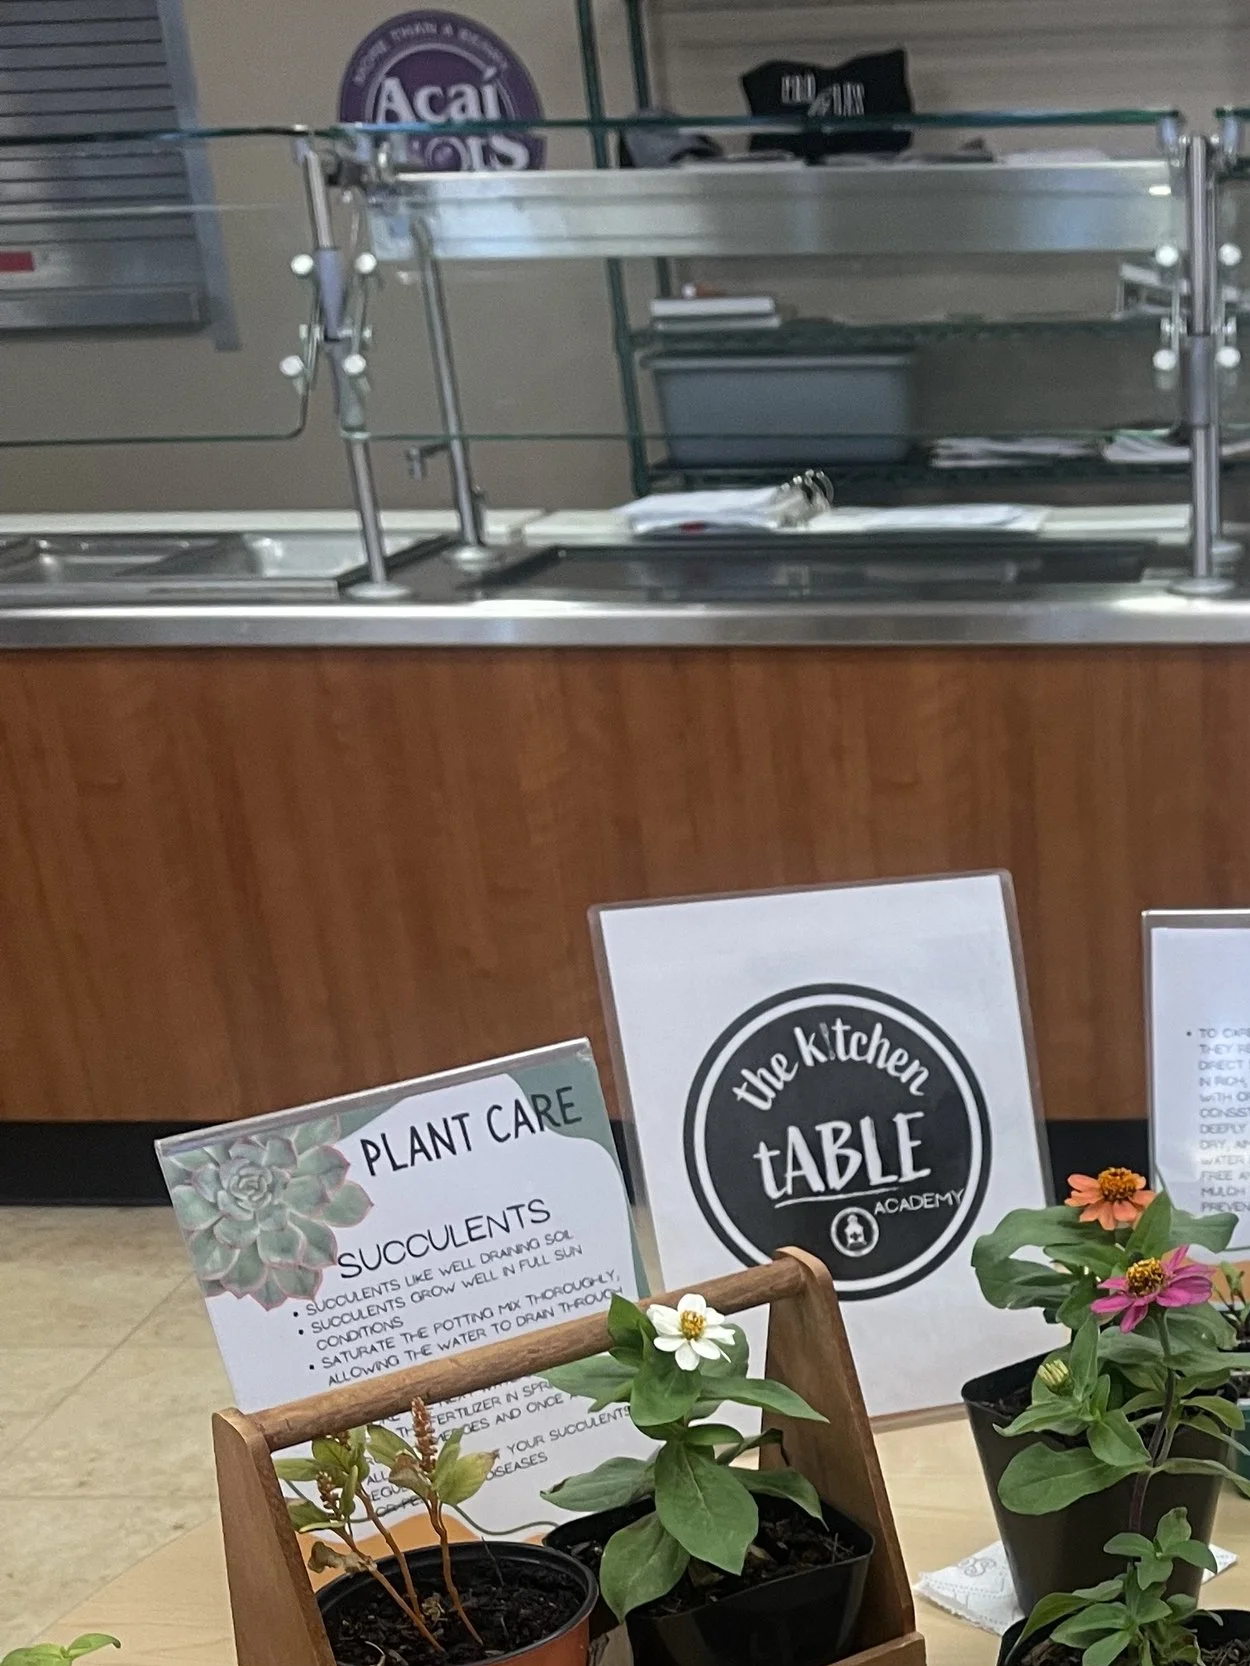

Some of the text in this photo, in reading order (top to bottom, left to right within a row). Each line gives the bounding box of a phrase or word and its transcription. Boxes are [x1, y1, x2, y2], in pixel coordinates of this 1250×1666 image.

[1198, 1028, 1217, 1038] TO
[732, 1018, 929, 1111] the kitchen
[360, 1086, 581, 1177] PLANT CARE
[1200, 1123, 1245, 1134] DEEPLY
[1201, 1170, 1232, 1180] FREE
[1201, 1185, 1244, 1196] MULCH
[874, 1188, 965, 1215] ACADEMY
[337, 1198, 551, 1279] SUCCULENTS
[304, 1227, 574, 1316] SUCCULENTS LIKE WELL DRAINING SOIL
[309, 1243, 583, 1334] SUCCULENTS GROW WELL IN FULL SUN
[315, 1315, 404, 1351] CONDITIONS
[320, 1335, 396, 1369] SATURATE
[400, 1326, 429, 1345] THE
[432, 1306, 494, 1334] POTTING
[497, 1298, 521, 1315] MIX
[325, 1306, 555, 1386] ALLOWING THE WATER TO DRAIN
[493, 1393, 564, 1424] AND ONCE
[505, 1390, 518, 1403] IN
[506, 1434, 545, 1455] YOUR
